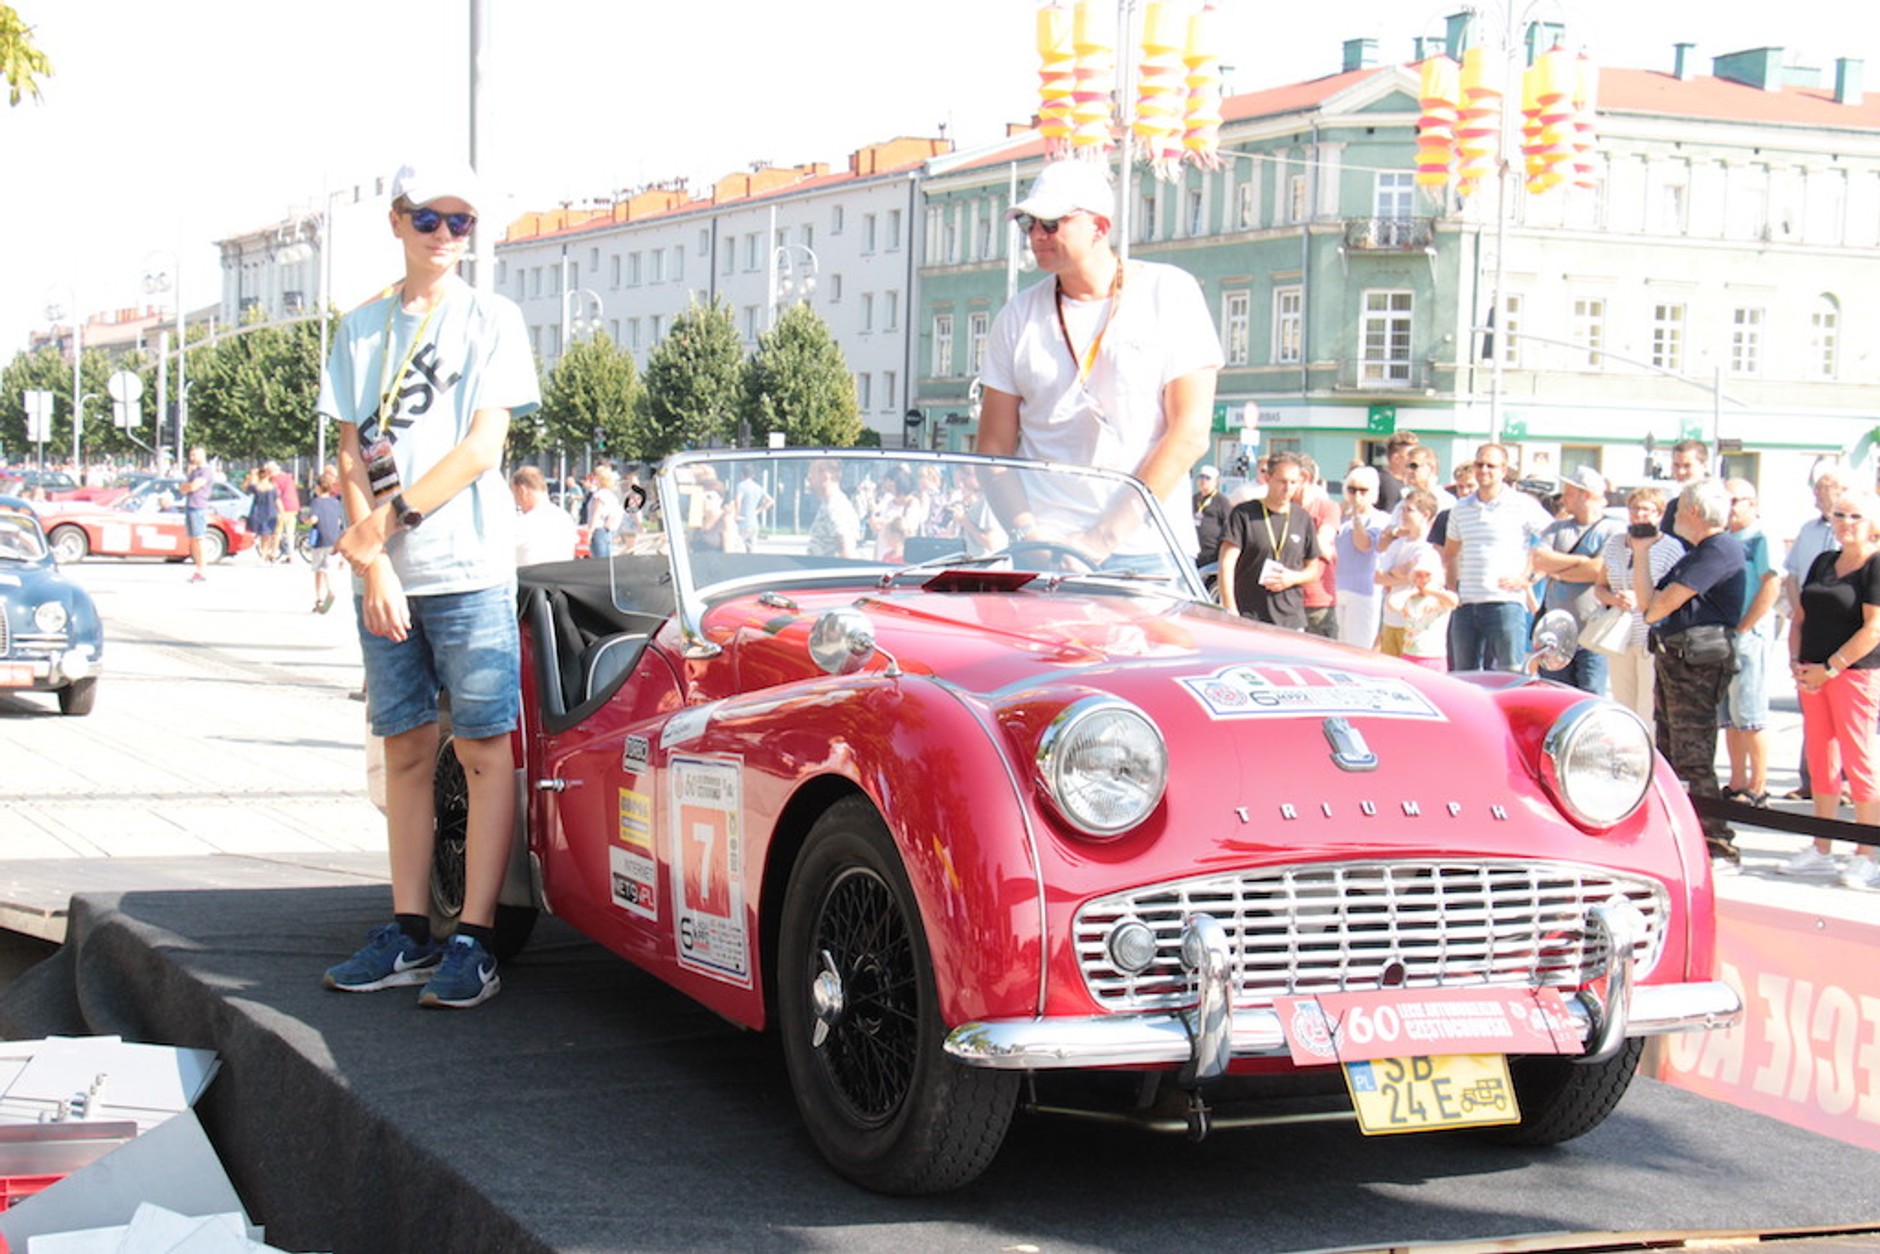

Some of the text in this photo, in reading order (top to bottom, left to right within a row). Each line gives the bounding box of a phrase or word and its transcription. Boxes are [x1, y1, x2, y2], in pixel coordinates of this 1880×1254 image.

[1235, 800, 1509, 823] TRIUMPH
[692, 822, 715, 899] 7
[1348, 1005, 1400, 1044] 60
[1354, 1075, 1375, 1092] PL
